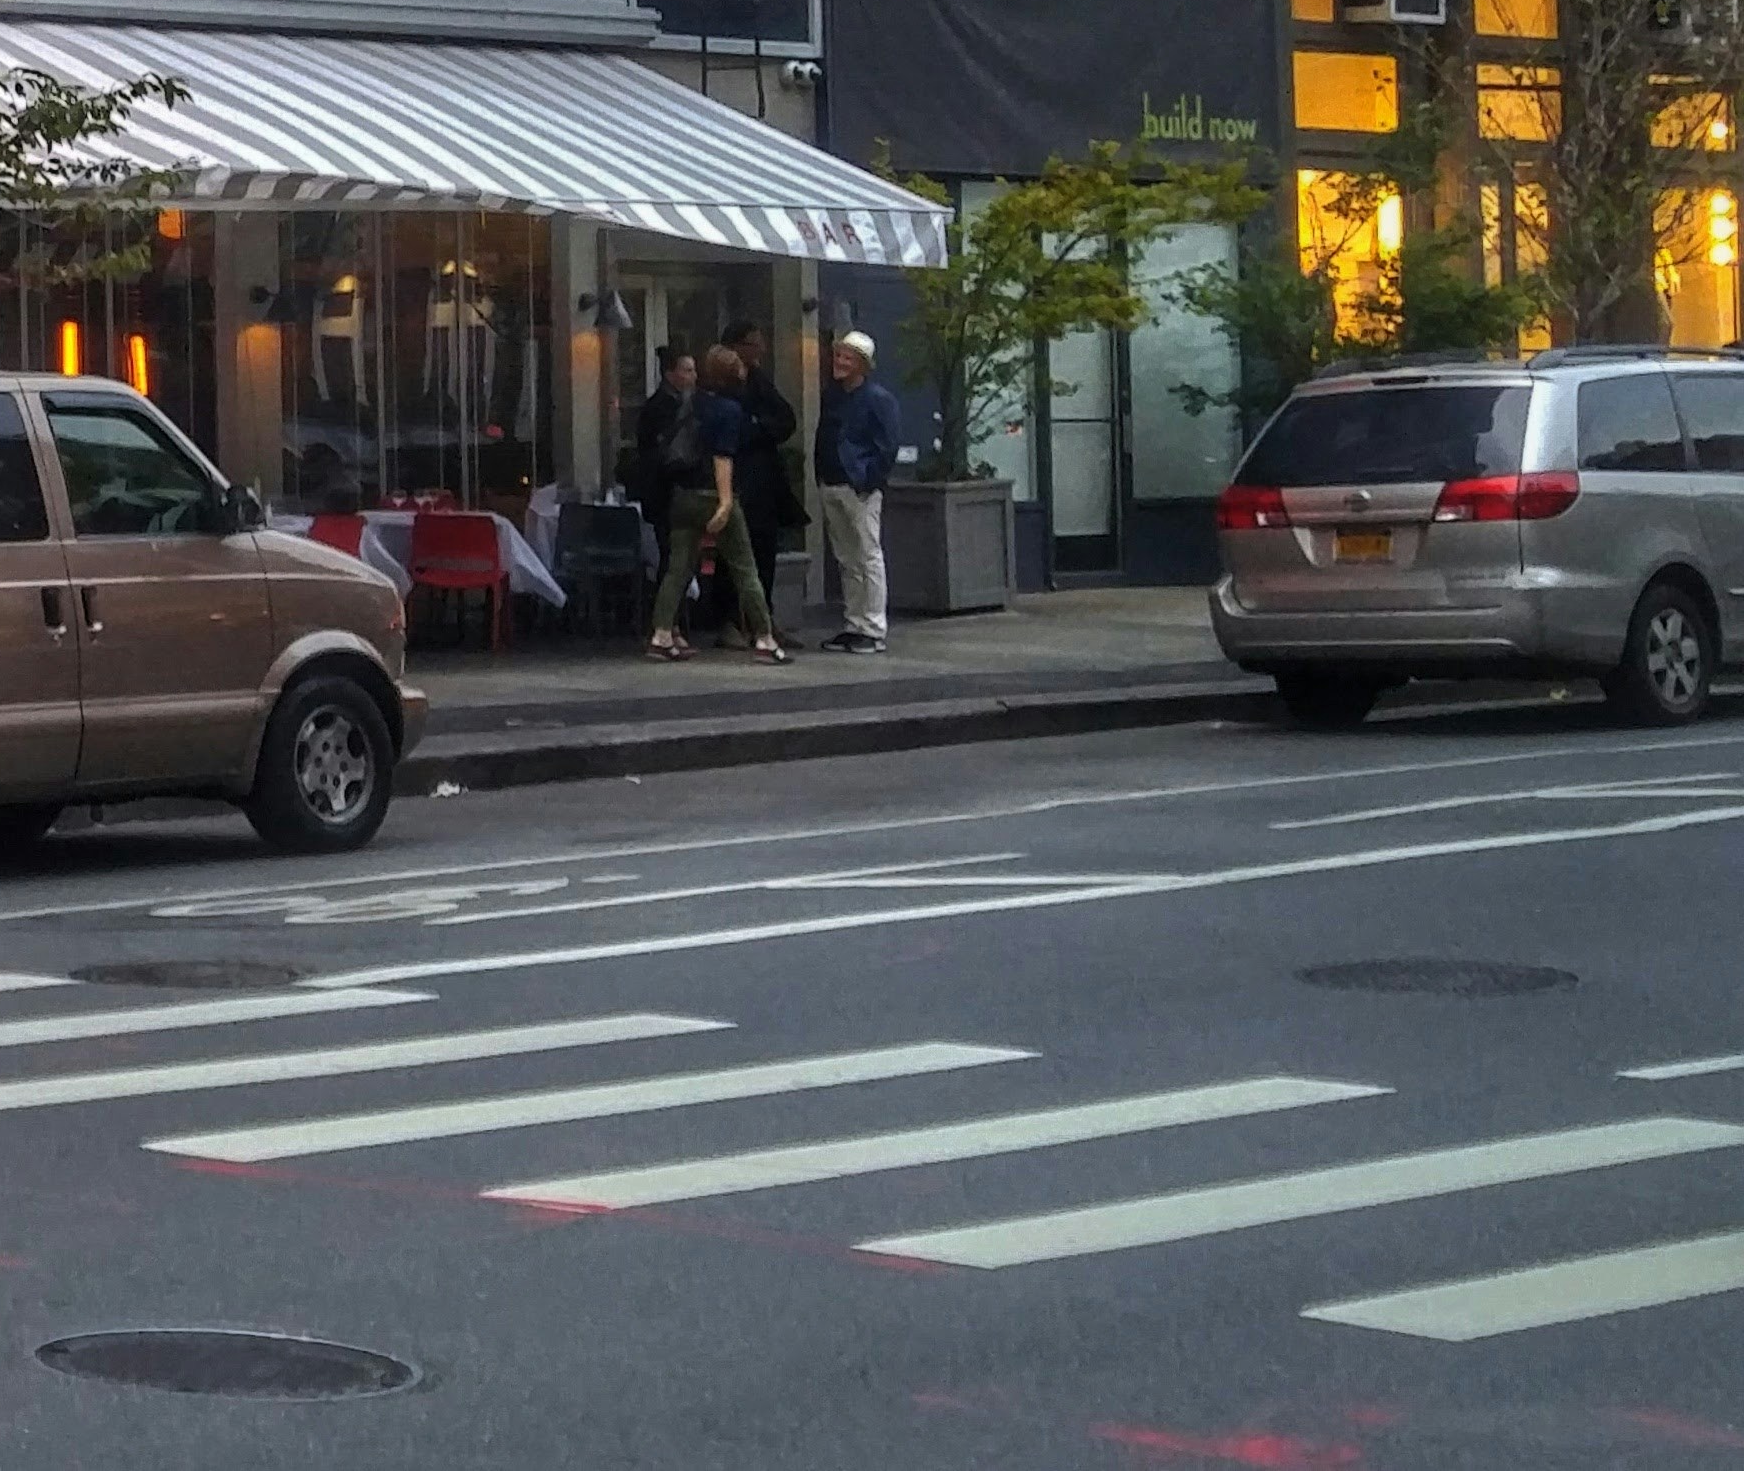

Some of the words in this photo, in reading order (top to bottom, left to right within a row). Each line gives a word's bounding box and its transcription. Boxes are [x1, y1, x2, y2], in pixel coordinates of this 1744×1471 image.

[1142, 92, 1203, 140] build
[1209, 117, 1257, 141] now
[797, 220, 862, 245] BAR
